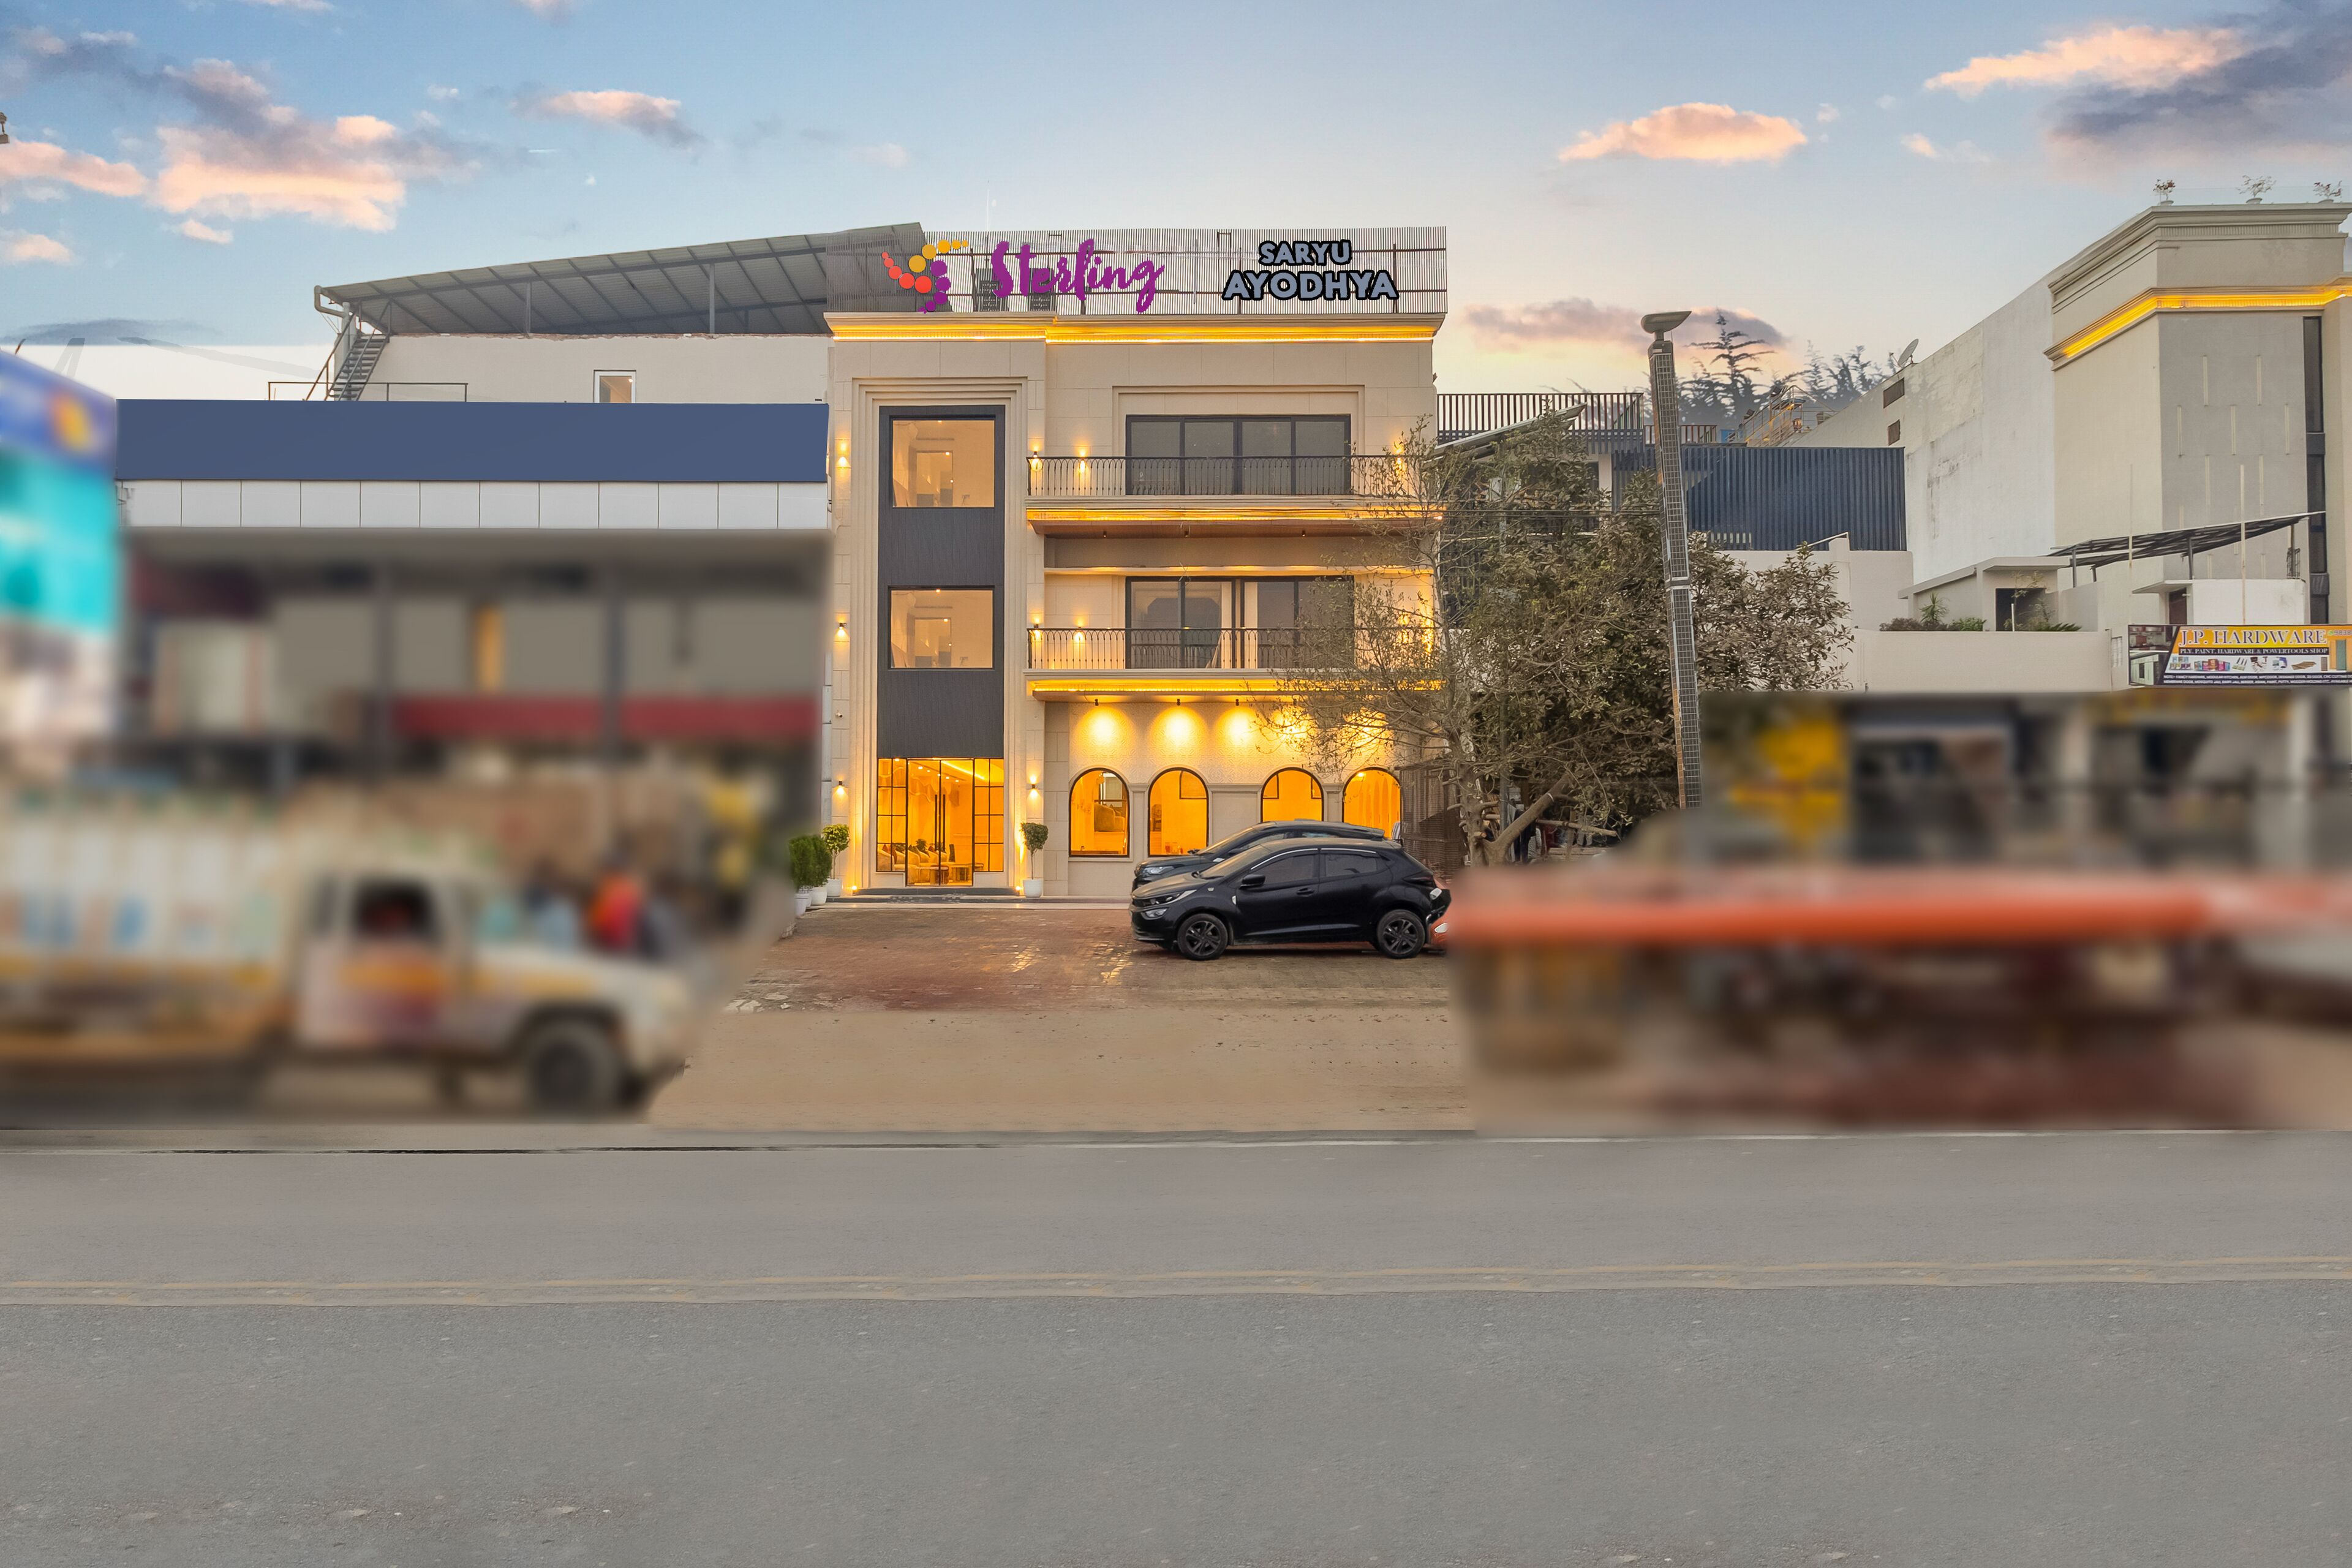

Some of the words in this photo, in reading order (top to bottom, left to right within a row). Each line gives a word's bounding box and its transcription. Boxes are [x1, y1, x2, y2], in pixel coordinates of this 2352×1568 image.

[1259, 239, 1352, 266] SARYU
[992, 238, 1164, 313] Sterling
[1221, 270, 1400, 300] AYODHYA
[2179, 629, 2208, 647] J.P.
[2212, 628, 2328, 645] HARDWARE
